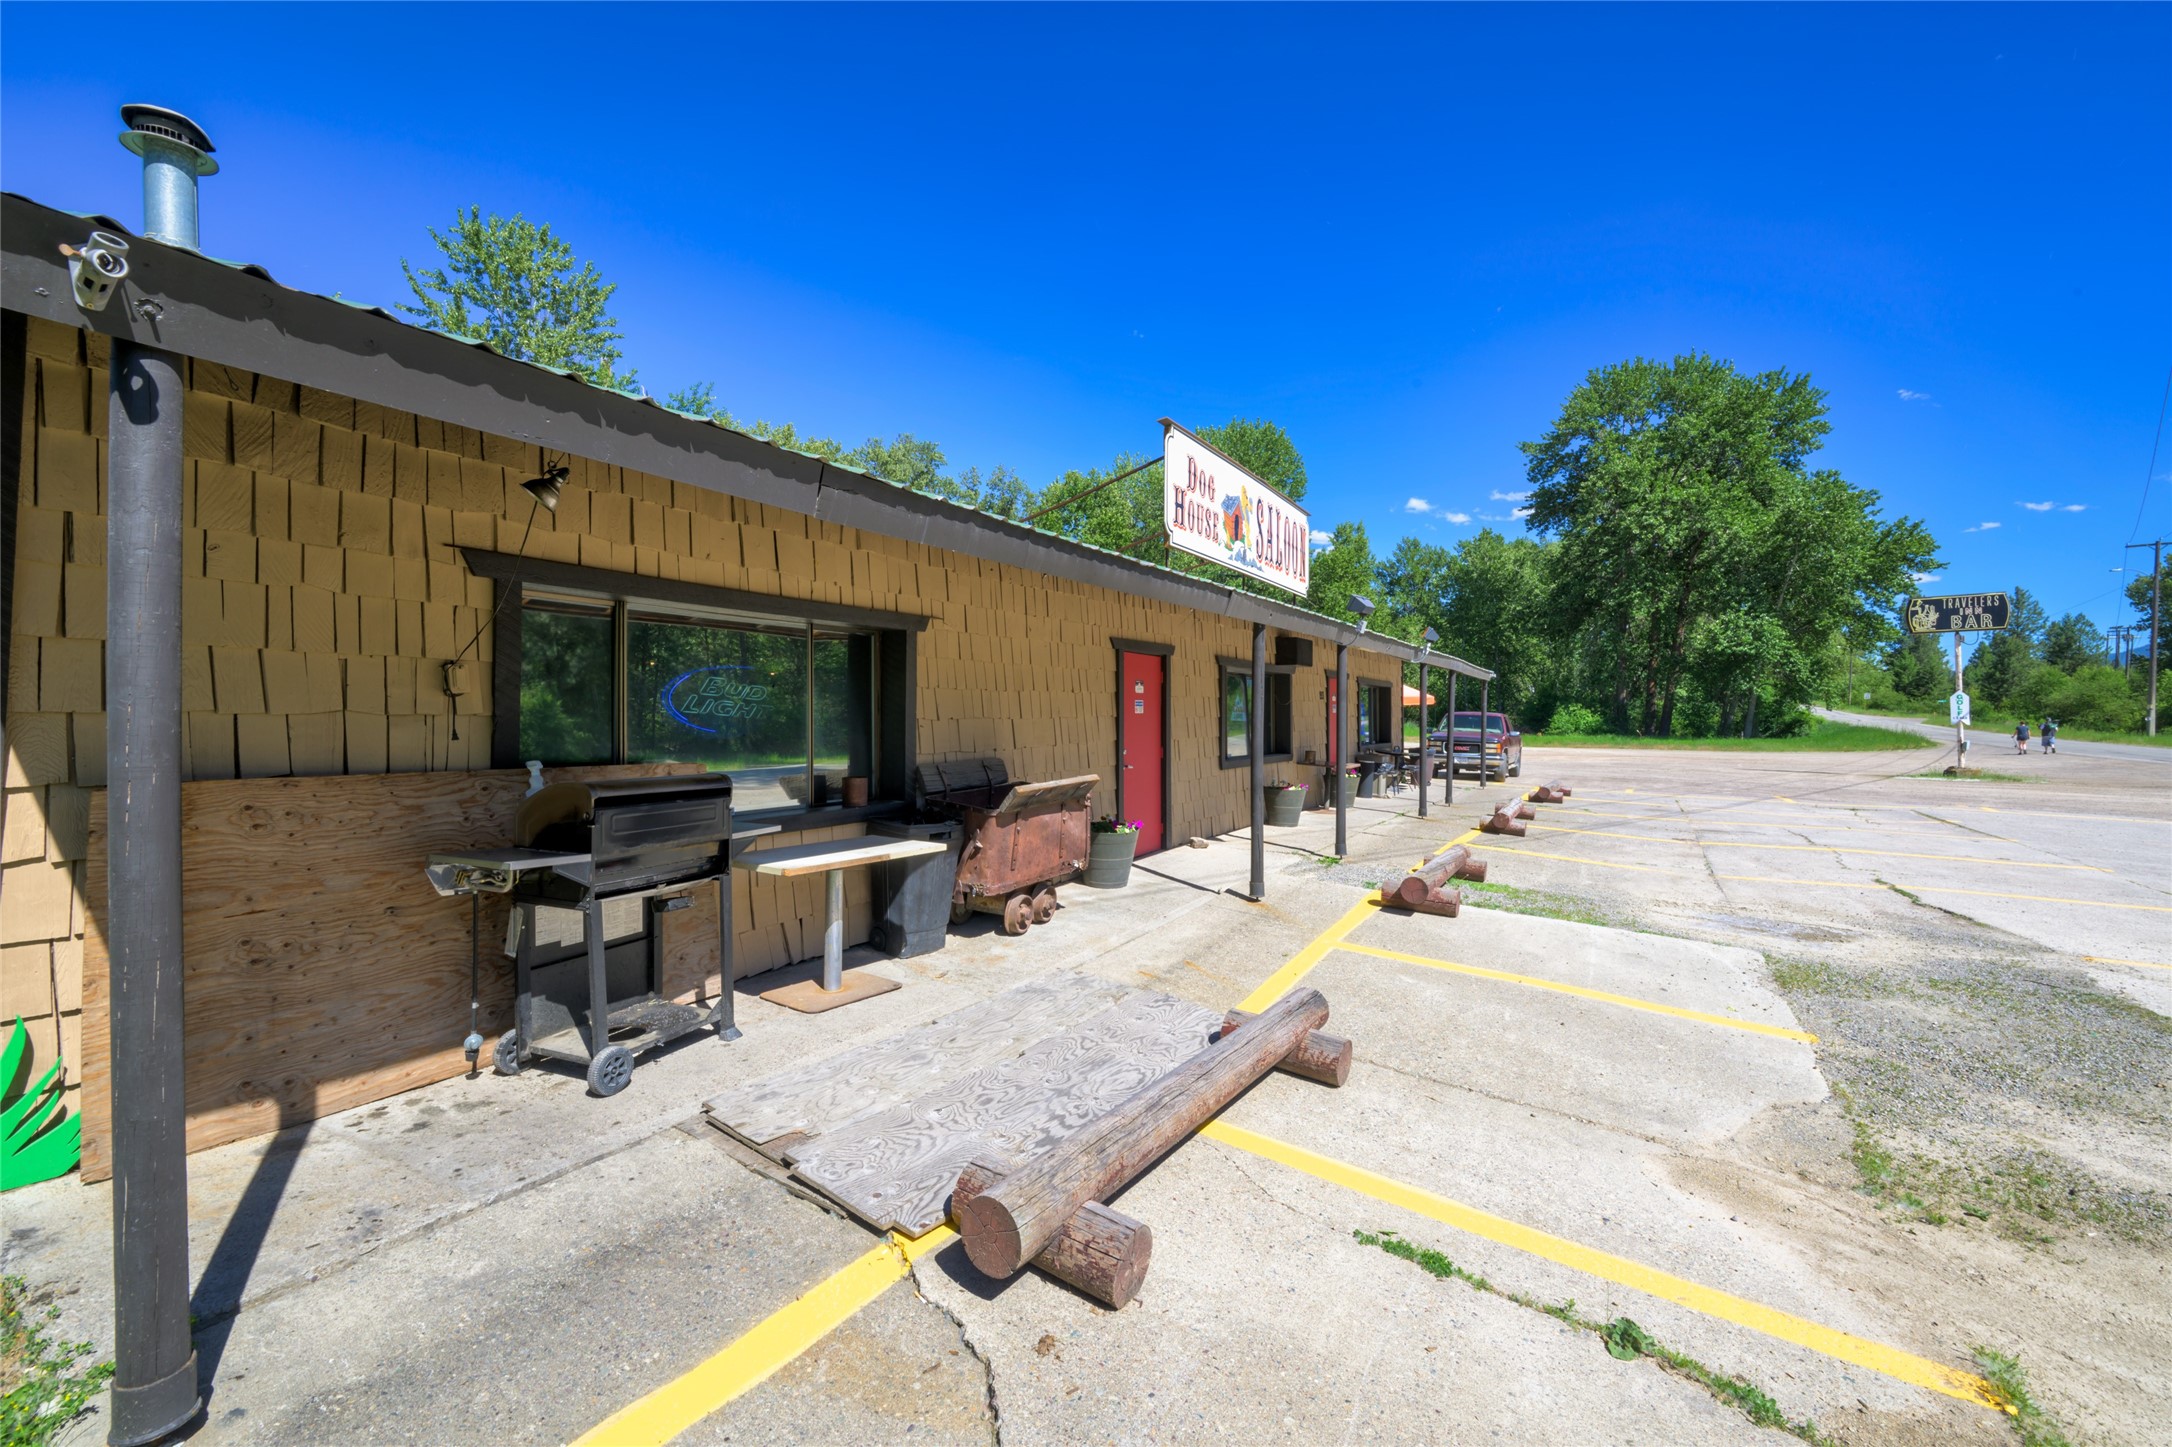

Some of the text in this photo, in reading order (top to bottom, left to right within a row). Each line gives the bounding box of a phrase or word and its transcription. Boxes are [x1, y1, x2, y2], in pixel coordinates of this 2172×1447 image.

[1256, 497, 1306, 582] SALOON
[1942, 595, 1999, 609] TRAVELERS
[1959, 606, 1983, 616] INN
[1950, 613, 1993, 629] BAR
[700, 676, 767, 701] BUD
[681, 694, 775, 719] LIGHT
[1956, 694, 1964, 716] GOLF
